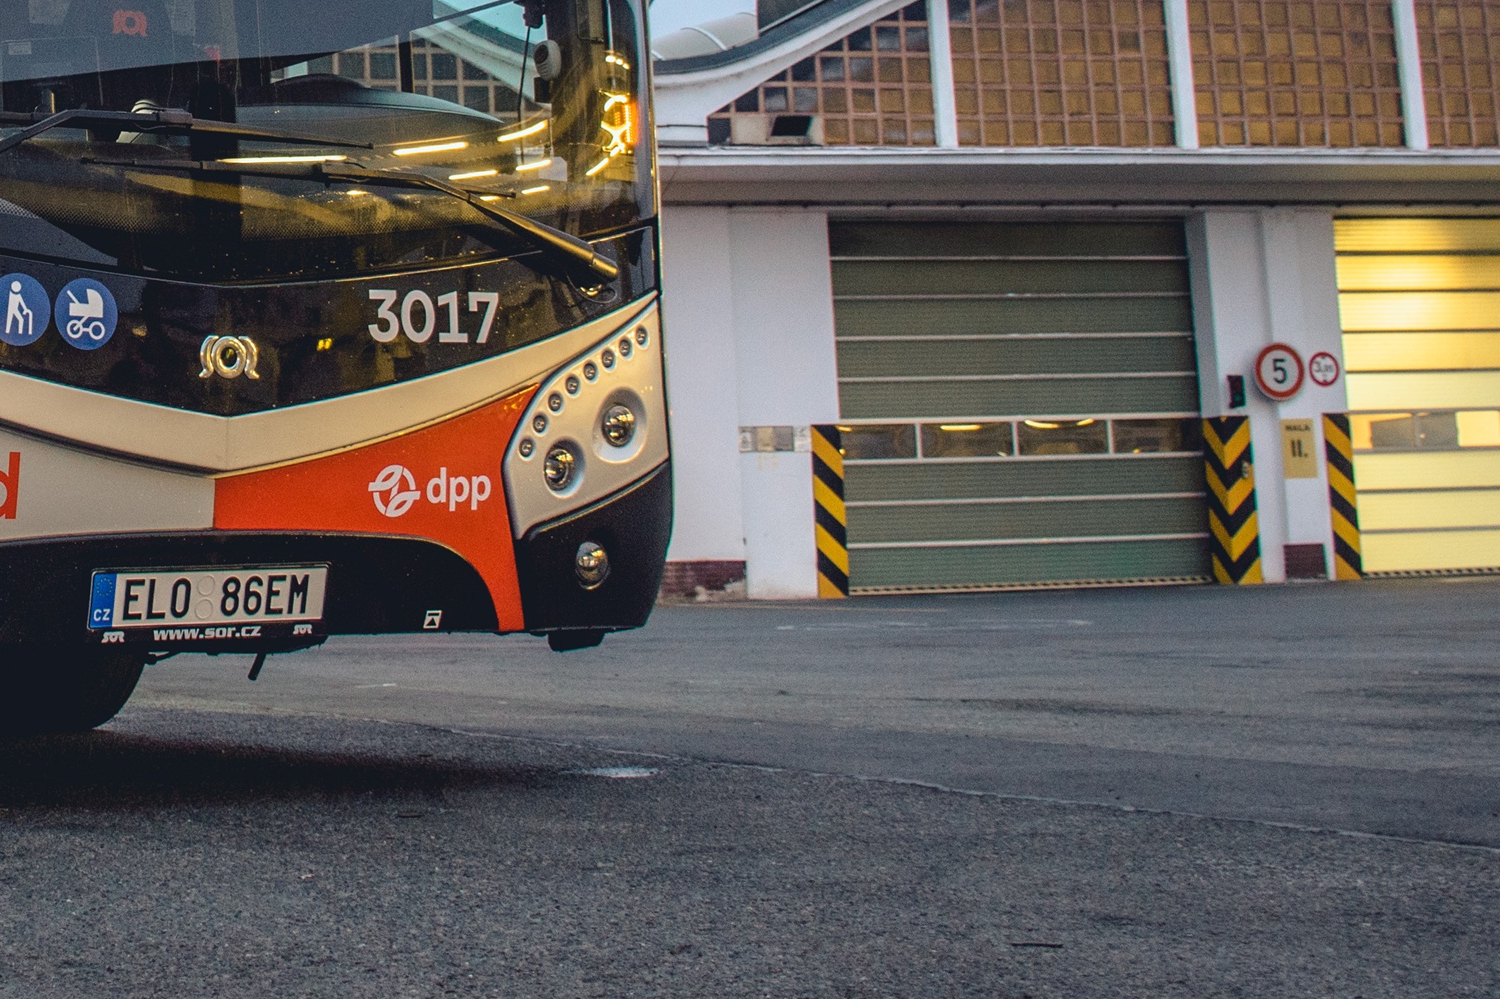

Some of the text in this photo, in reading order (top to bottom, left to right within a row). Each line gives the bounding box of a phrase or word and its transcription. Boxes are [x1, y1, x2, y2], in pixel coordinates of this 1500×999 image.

[368, 289, 499, 344] 3017
[1273, 358, 1288, 385] 5
[426, 467, 492, 511] dpp
[219, 573, 311, 617] 86EM
[93, 608, 111, 621] CZ
[152, 625, 262, 642] www.sor.cz
